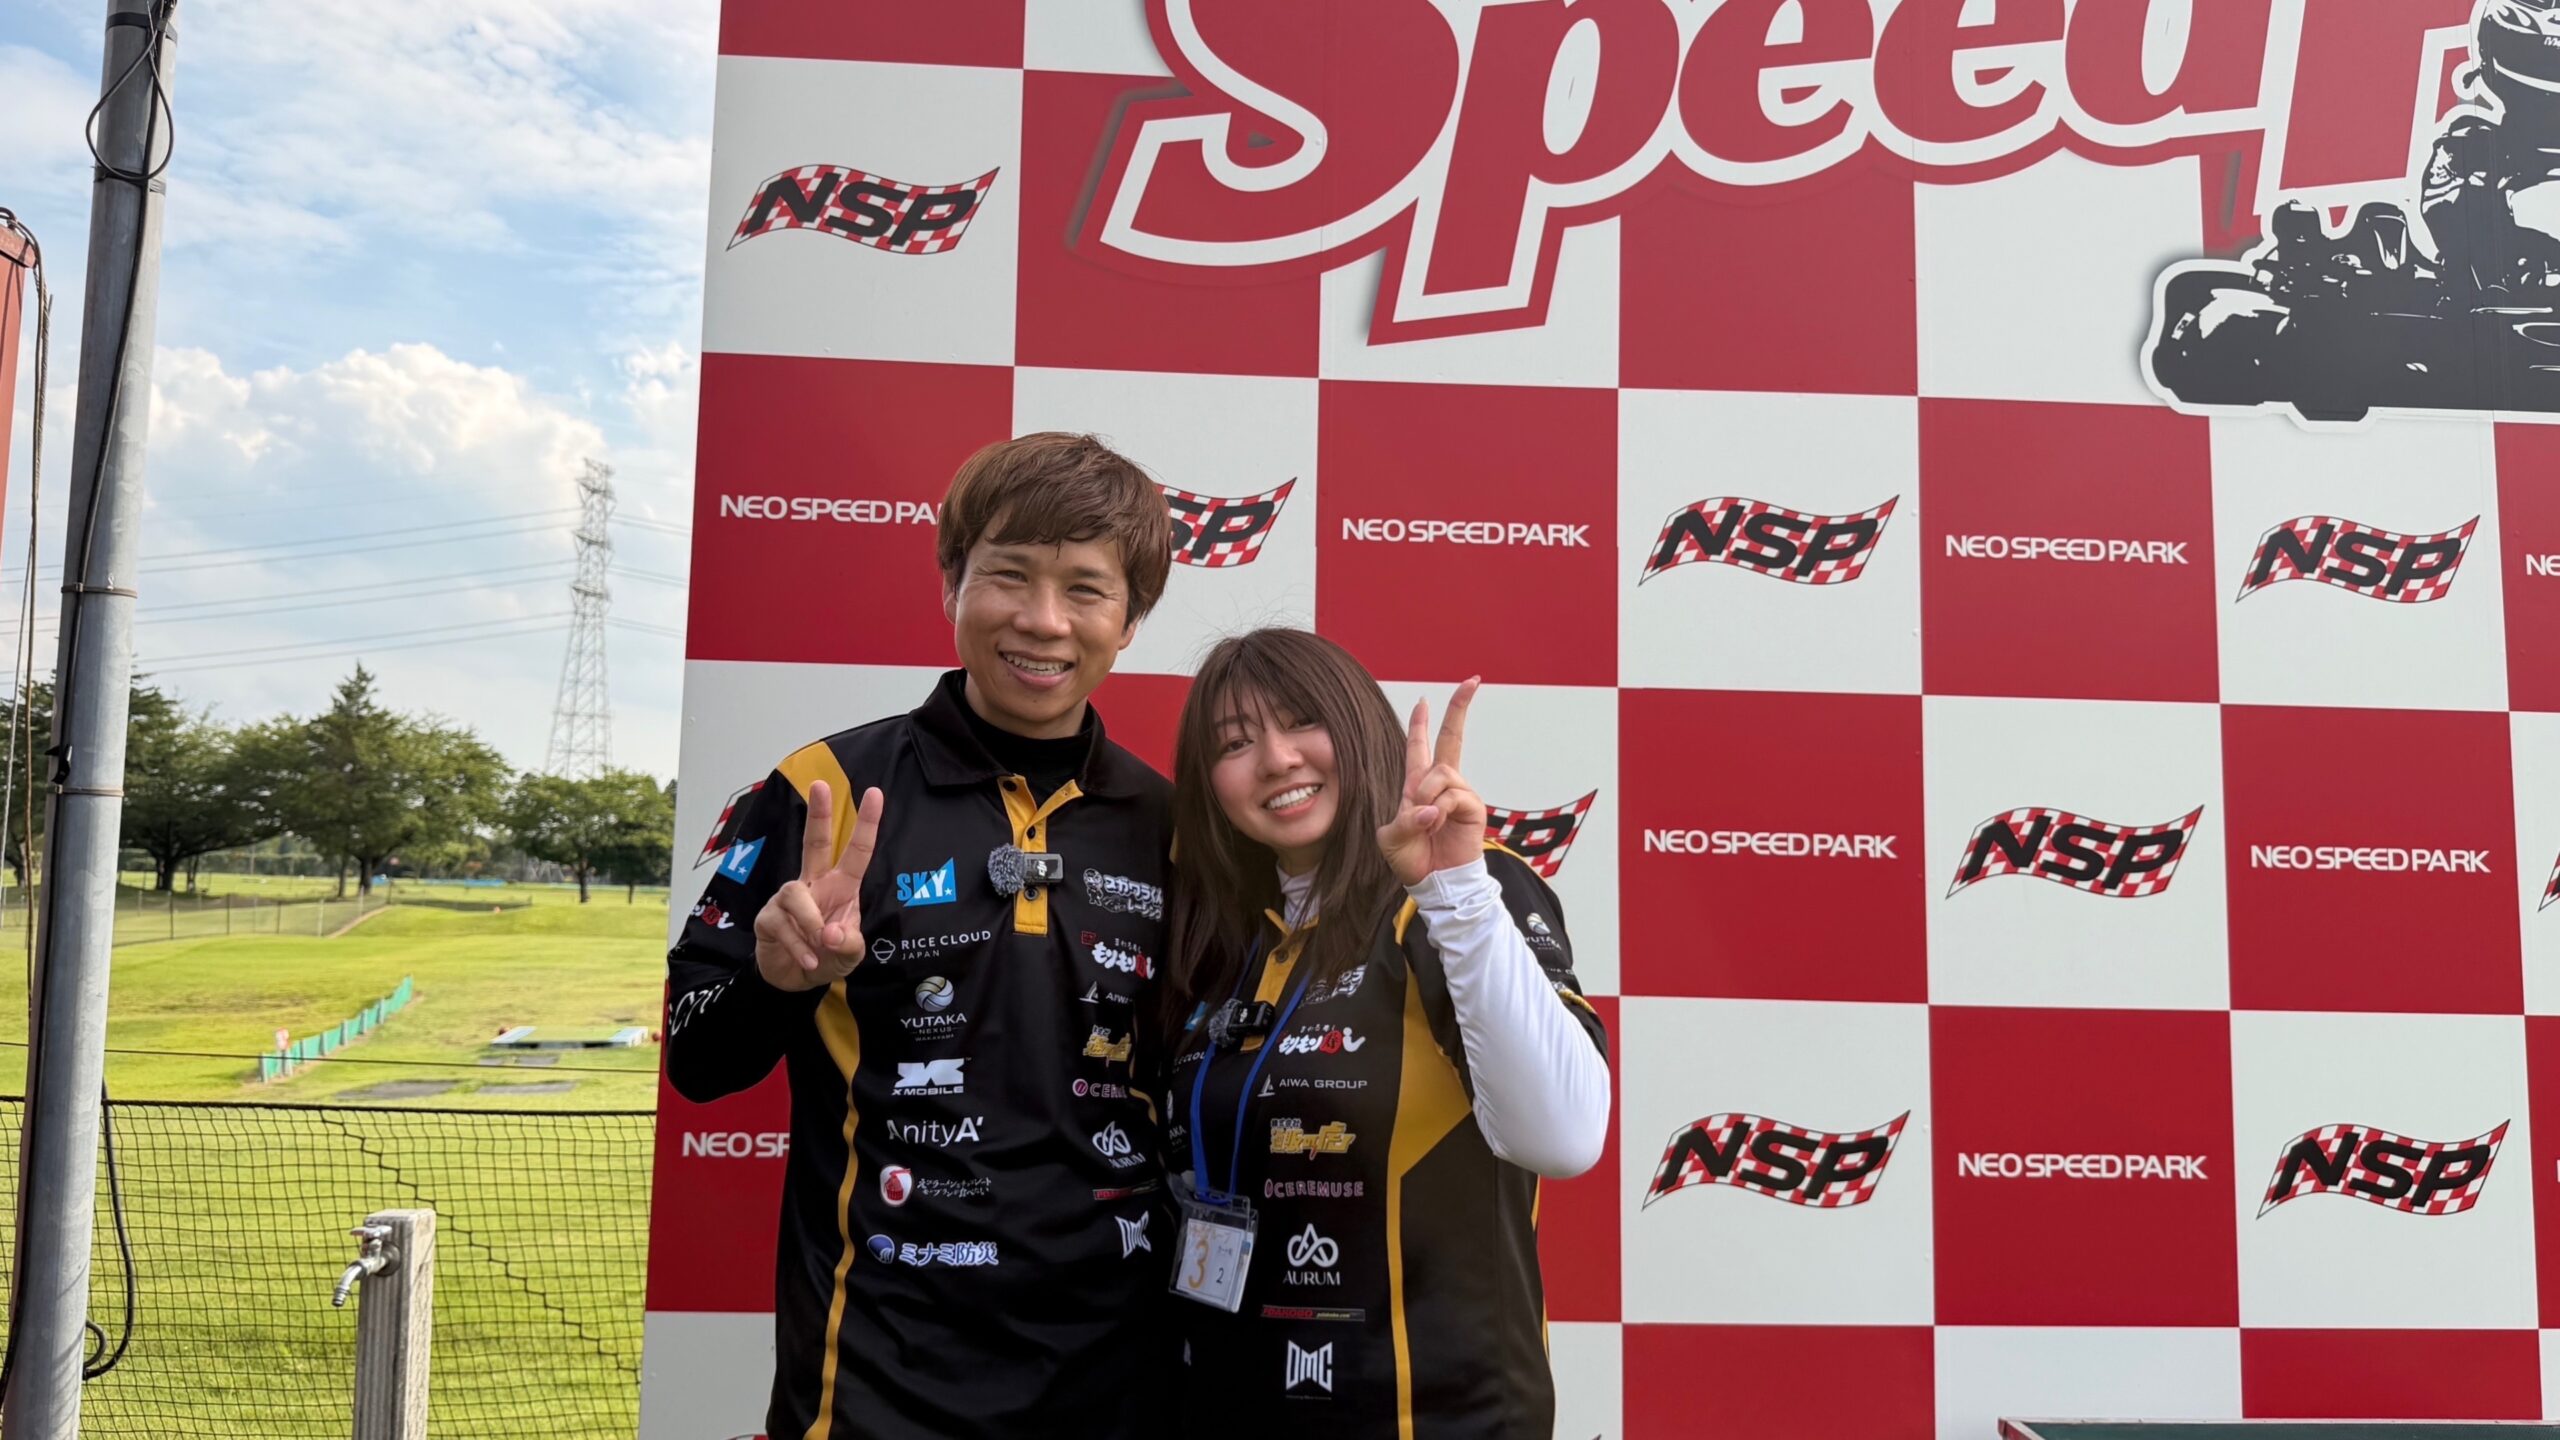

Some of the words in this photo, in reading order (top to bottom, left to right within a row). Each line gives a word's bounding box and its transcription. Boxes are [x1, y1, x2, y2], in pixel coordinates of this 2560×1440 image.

[741, 172, 977, 246] NSP
[720, 494, 788, 520] NEO
[790, 497, 893, 523] SPEED
[895, 501, 942, 525] PA
[1165, 494, 1275, 560] SP
[1342, 517, 1406, 542] NEO
[1408, 520, 1506, 545] SPEED
[1507, 522, 1590, 547] PARK
[1651, 504, 1878, 577] NSP
[1945, 534, 2009, 559] NEO
[2010, 536, 2107, 562] SPEED
[2108, 539, 2189, 565] PARK
[2248, 523, 2461, 595] NSP
[2525, 553, 2560, 577] NE
[1644, 829, 1709, 854] NEO
[1711, 831, 1811, 856] SPEED
[1812, 833, 1897, 859] PARK
[1959, 815, 2184, 890] NSP
[2250, 845, 2313, 869] NEO
[2314, 846, 2410, 871] SPEED
[2411, 848, 2491, 873] PARK
[896, 869, 948, 902] SKY
[901, 937, 936, 950] RICE
[939, 930, 992, 946] CLOUD
[902, 949, 940, 961] JAPAN
[900, 1012, 967, 1029] YUTAKA
[918, 1026, 952, 1035] NEXUS
[1279, 1078, 1310, 1088] AIWA
[1313, 1079, 1368, 1090] GROUP
[683, 1132, 752, 1157] NEO
[1656, 1122, 1889, 1200] NSP
[1958, 1152, 2023, 1178] NEO
[2024, 1153, 2123, 1179] SPEED
[2125, 1154, 2207, 1180] PARK
[2268, 1132, 2491, 1208] NSP
[1273, 1181, 1364, 1198] CEREMUSE
[899, 1242, 999, 1266] ミナミ防災
[1215, 1266, 1225, 1284] 2
[1282, 1270, 1341, 1286] AURUM
[1285, 1339, 1333, 1393] DMC
